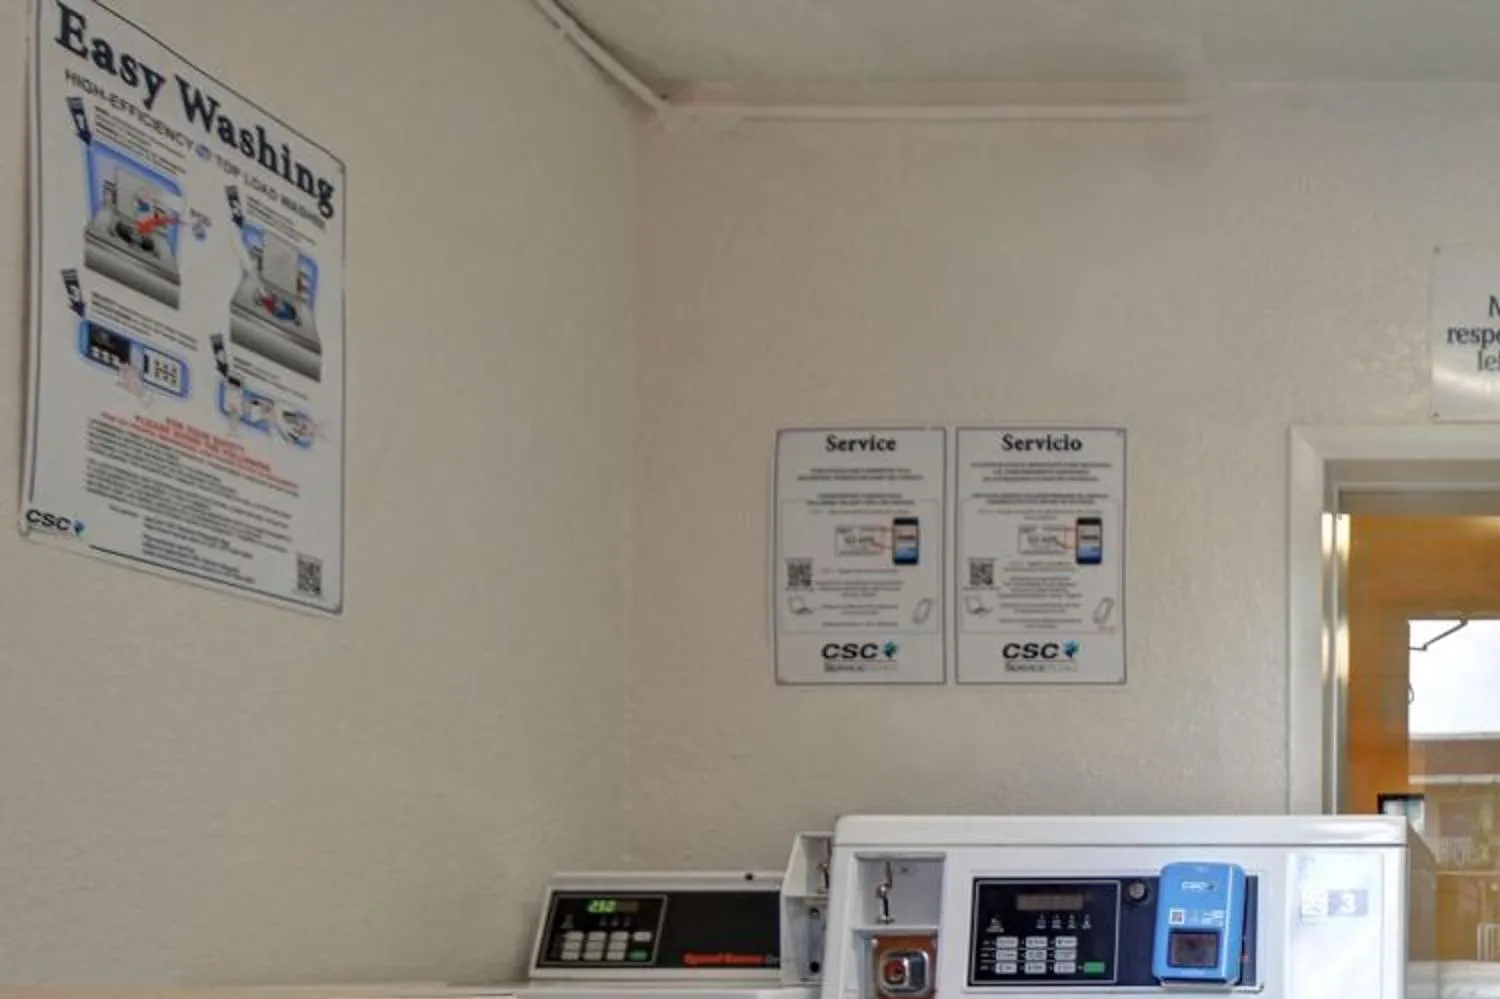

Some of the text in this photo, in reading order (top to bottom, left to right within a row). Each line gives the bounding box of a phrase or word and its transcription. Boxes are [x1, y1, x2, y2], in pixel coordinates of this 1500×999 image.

[54, 1, 166, 110] Easy
[174, 73, 335, 219] Washing
[825, 434, 896, 452] Service
[1002, 433, 1083, 452] Servicio
[26, 509, 72, 531] CSC
[822, 642, 879, 659] CSC
[1002, 642, 1059, 659] CSC
